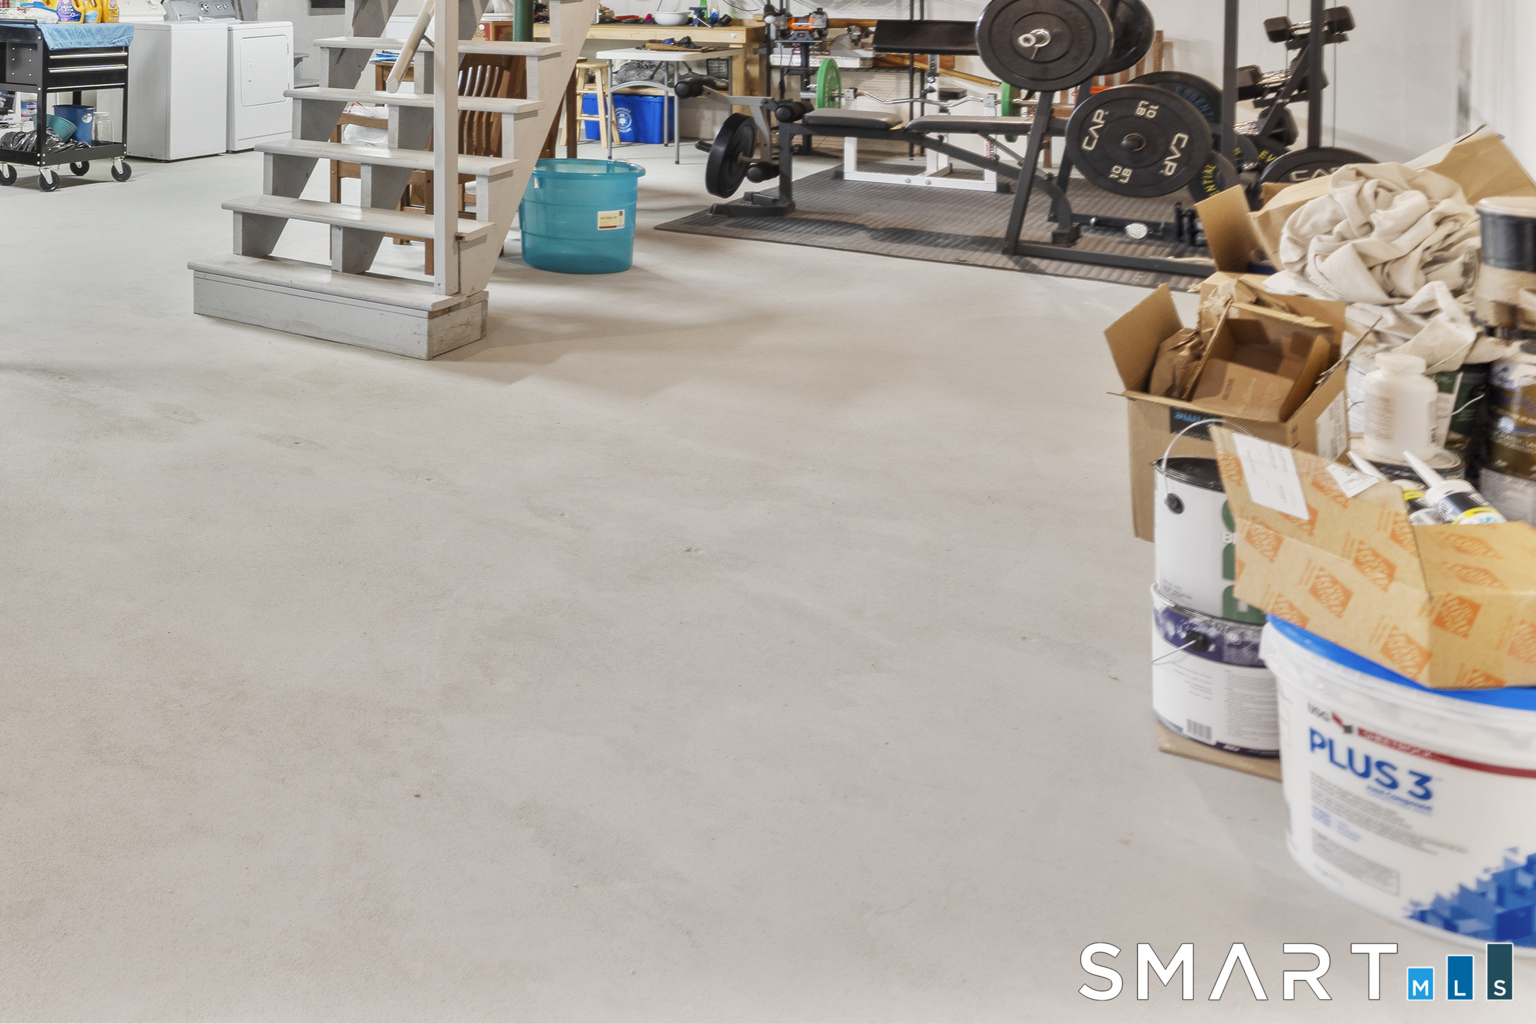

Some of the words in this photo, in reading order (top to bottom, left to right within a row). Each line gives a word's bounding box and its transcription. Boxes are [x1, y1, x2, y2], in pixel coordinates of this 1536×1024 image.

[1081, 109, 1107, 151] CAP
[1161, 132, 1190, 176] CAP
[1309, 726, 1400, 790] PLUS
[1407, 769, 1434, 801] 3
